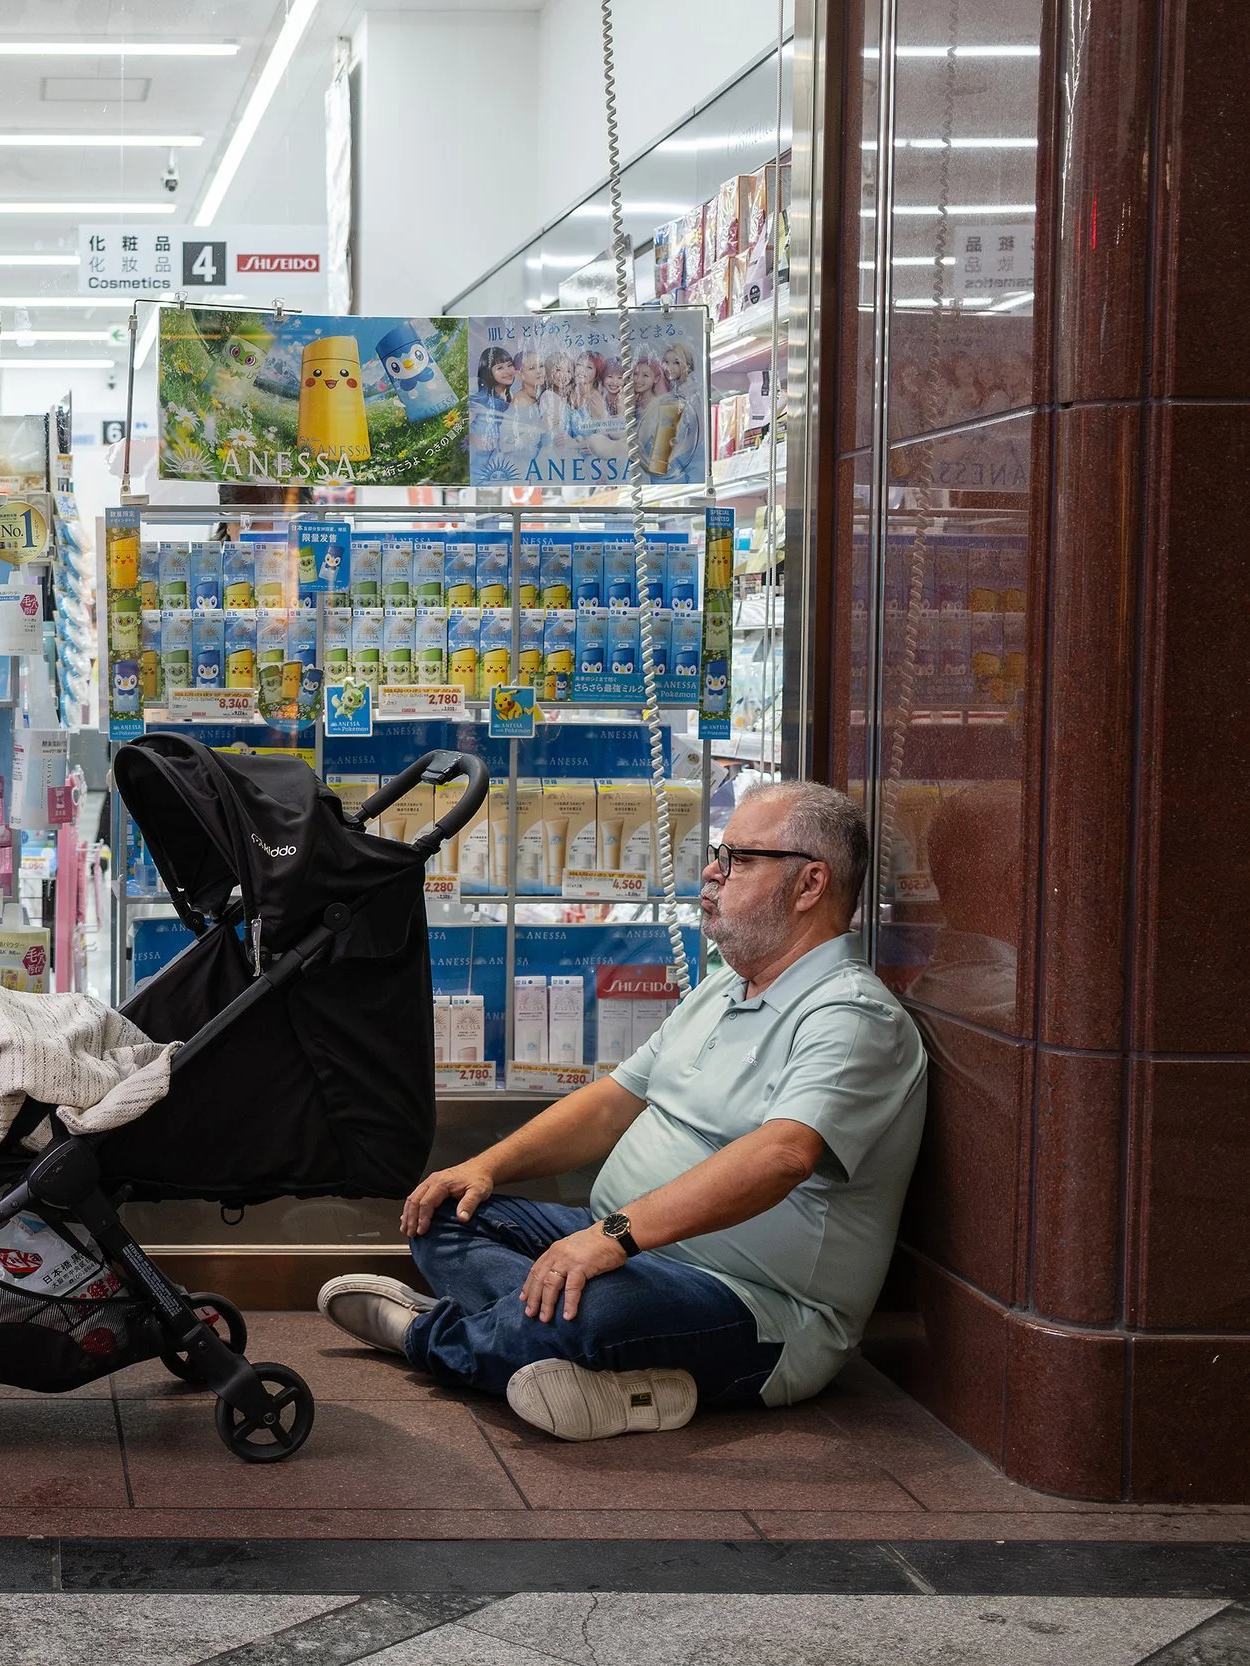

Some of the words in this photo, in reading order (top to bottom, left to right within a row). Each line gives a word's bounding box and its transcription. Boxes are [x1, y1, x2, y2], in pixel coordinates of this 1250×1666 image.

[89, 235, 171, 252] 化粧品
[191, 245, 217, 282] 4
[240, 256, 317, 271] SHISEIDO
[88, 277, 171, 289] Cosmetics
[488, 326, 515, 342] 肌と
[106, 423, 122, 442] 6
[318, 444, 370, 458] ANESSA
[222, 449, 356, 480] ANESSA
[525, 457, 635, 481] ANESSA
[302, 534, 337, 543] 限量发售
[21, 596, 37, 609] 毛穴
[573, 682, 645, 694] さらさら最強ミルク
[663, 681, 697, 689] ANESSA
[219, 698, 249, 709] 8,340
[428, 694, 458, 706] 2,780
[386, 727, 422, 736] ANESSA
[601, 731, 639, 739] ANESSA
[338, 755, 376, 765] ANESSA
[549, 757, 589, 766] ANESSA
[424, 881, 454, 893] 2,280
[612, 879, 642, 890] 4,560
[526, 931, 567, 940] ANESSA
[626, 929, 667, 939] ANESSA
[26, 949, 45, 964] 毛穴
[574, 956, 615, 965] ANESSA
[603, 979, 674, 993] SHISEIDO
[459, 1069, 489, 1080] 2,780
[557, 1073, 587, 1084] 2,280
[43, 1260, 72, 1284] 日本橋
